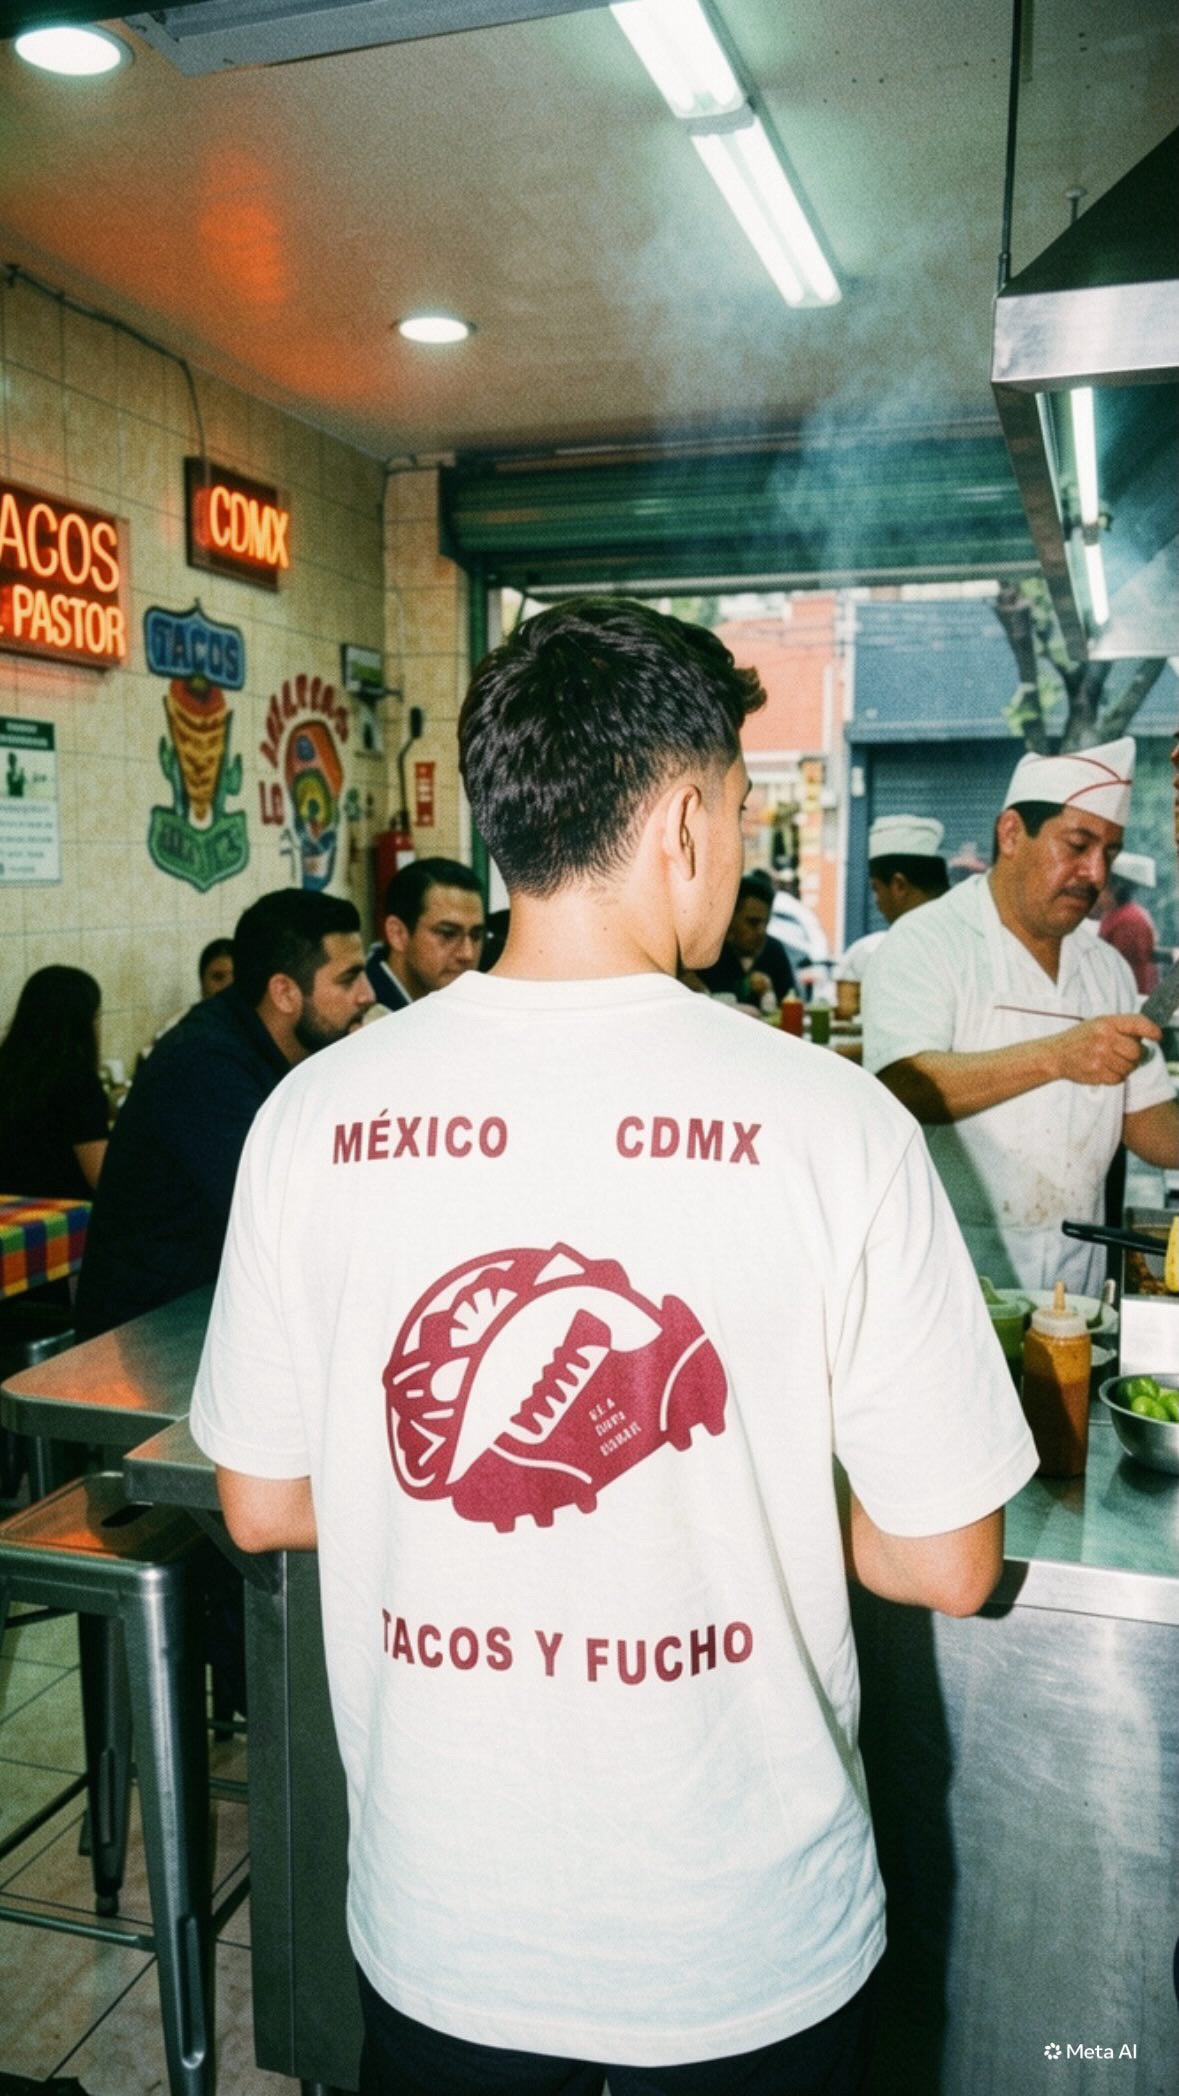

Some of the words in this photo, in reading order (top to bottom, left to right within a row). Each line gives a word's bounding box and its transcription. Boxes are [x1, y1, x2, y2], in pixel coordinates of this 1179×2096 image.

[0, 493, 120, 593] ACOS
[209, 486, 289, 569] CDMX
[12, 584, 126, 658] PASTOR
[151, 616, 240, 682] TACOS
[333, 1109, 509, 1164] MÉXICO
[616, 1115, 762, 1165] CDMX
[382, 1608, 513, 1671] TACOS
[534, 1630, 563, 1677] Y
[586, 1621, 753, 1685] FUCHO
